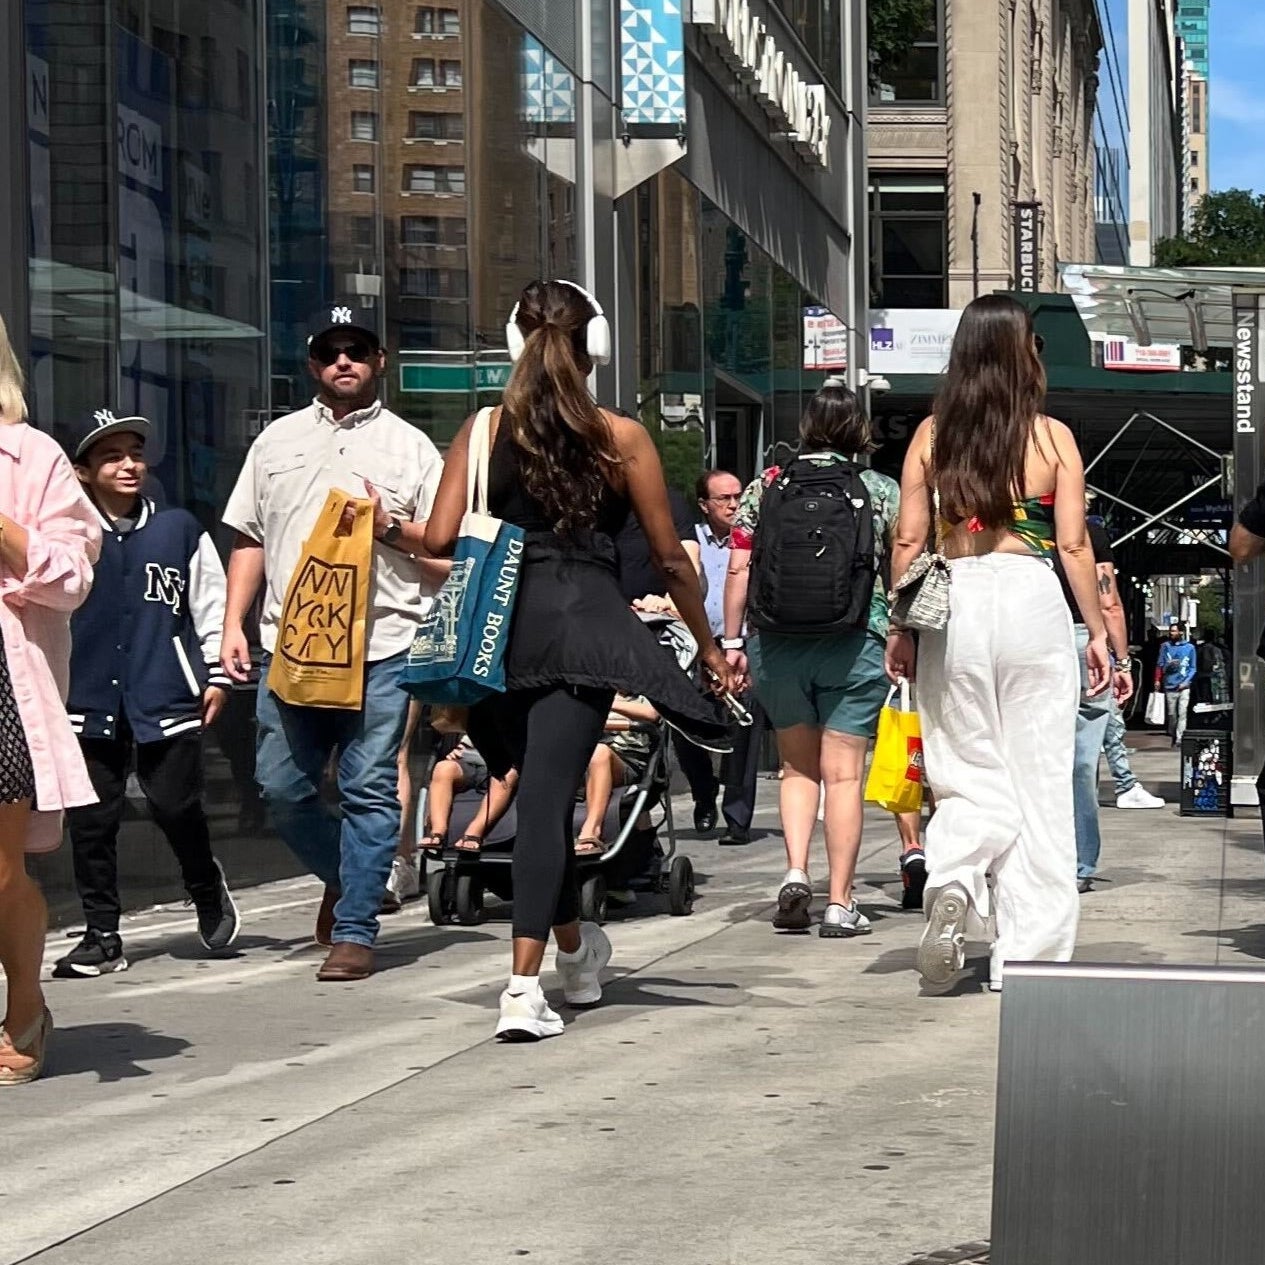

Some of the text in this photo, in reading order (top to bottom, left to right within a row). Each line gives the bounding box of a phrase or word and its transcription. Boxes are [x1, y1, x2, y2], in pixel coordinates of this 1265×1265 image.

[1236, 311, 1256, 433] Newsstand
[492, 538, 524, 607] DAUNT
[472, 610, 505, 678] BOOKS
